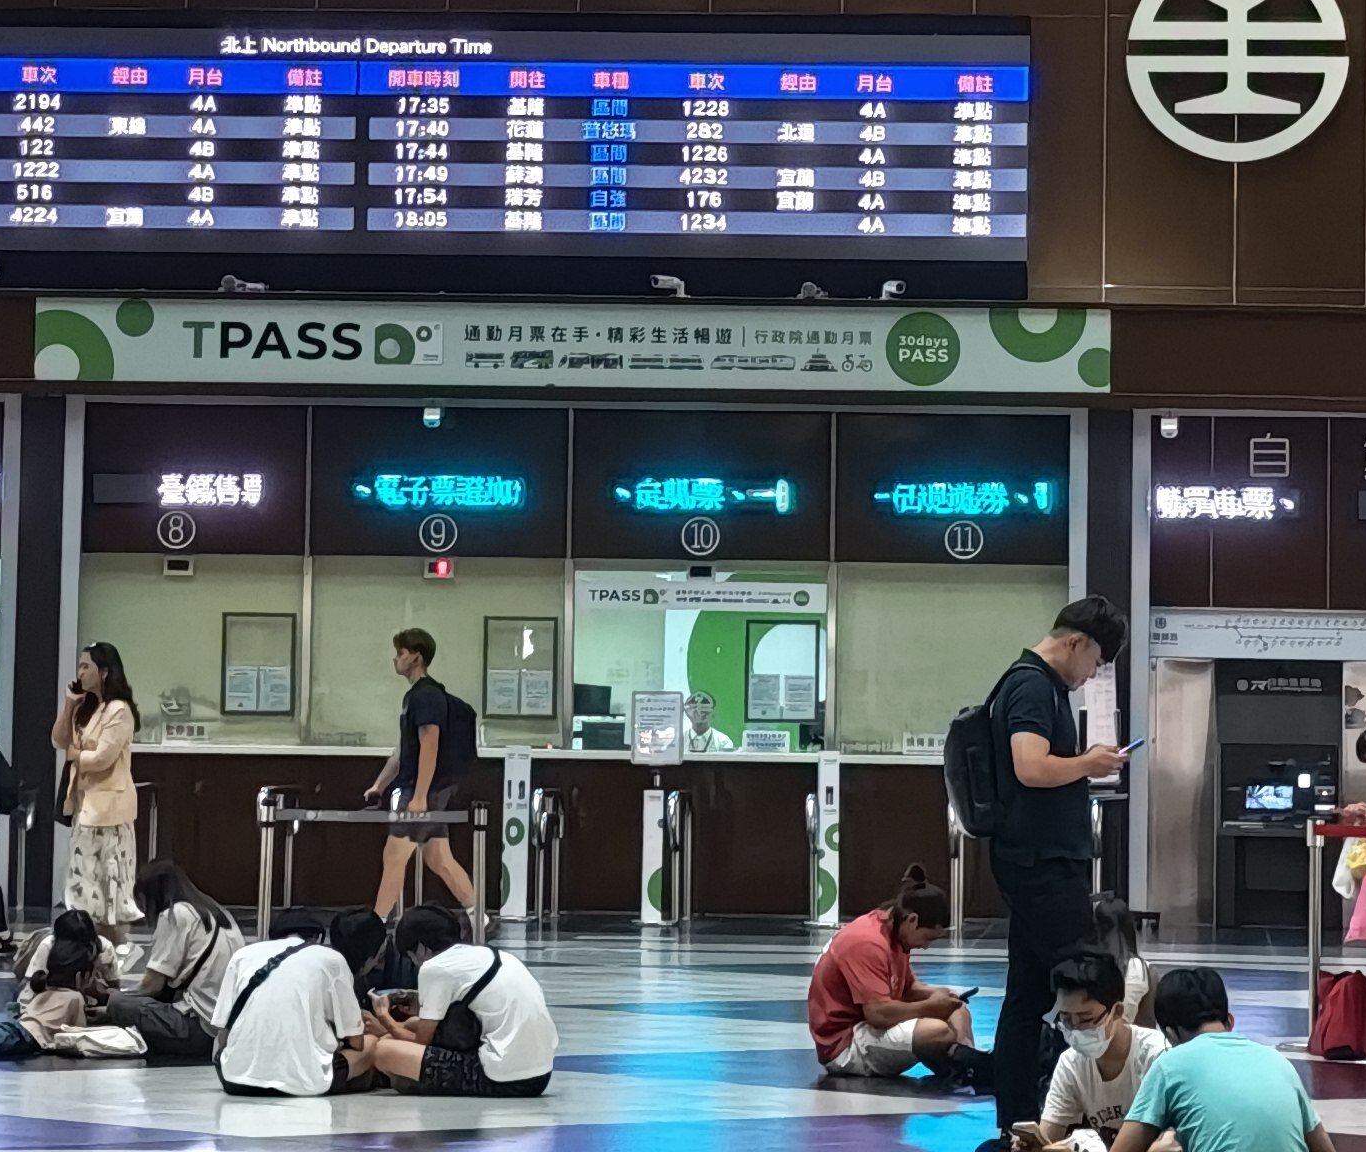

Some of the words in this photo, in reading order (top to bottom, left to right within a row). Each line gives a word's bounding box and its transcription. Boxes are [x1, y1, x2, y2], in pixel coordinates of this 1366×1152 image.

[221, 36, 257, 54] 北上
[262, 37, 360, 53] Northbound
[365, 38, 446, 56] Departure
[450, 38, 492, 54] Time
[22, 66, 56, 83] 車次
[113, 67, 147, 84] 經由
[189, 68, 222, 85] 月台
[288, 69, 322, 86] 備註
[389, 70, 459, 87] 開車時刻
[510, 71, 545, 88] 開往
[594, 72, 629, 89] 車種
[689, 73, 724, 90] 車次
[781, 74, 816, 91] 經由
[858, 75, 892, 92] 月台
[958, 75, 992, 92] 備註
[14, 94, 60, 110] 2194
[191, 95, 216, 111] 4A
[399, 97, 449, 114] 17:35
[683, 101, 729, 116] 1228
[860, 103, 886, 118] 4A
[18, 116, 54, 132] 442
[189, 118, 216, 135] 4A
[396, 120, 448, 137] 17:40
[687, 122, 723, 140] 282
[860, 125, 885, 141] 4B
[20, 139, 53, 155] 122
[190, 141, 214, 156] 4B
[396, 143, 447, 159] 17:44
[682, 145, 727, 162] 1226
[859, 148, 885, 164] 4A
[13, 162, 59, 178] 1222
[188, 164, 215, 180] 4A
[395, 165, 448, 182] 17:49
[680, 168, 727, 185] 4232
[859, 171, 885, 187] 4B
[17, 184, 52, 200] 516
[395, 188, 447, 204] 17:54
[687, 191, 721, 207] 176
[10, 207, 58, 225] 4224
[394, 211, 447, 228] 18:05
[681, 214, 726, 231] 1234
[183, 321, 362, 360] TPASS
[898, 334, 949, 350] 30days
[898, 347, 949, 364] PASS
[588, 588, 641, 602] TPASS
